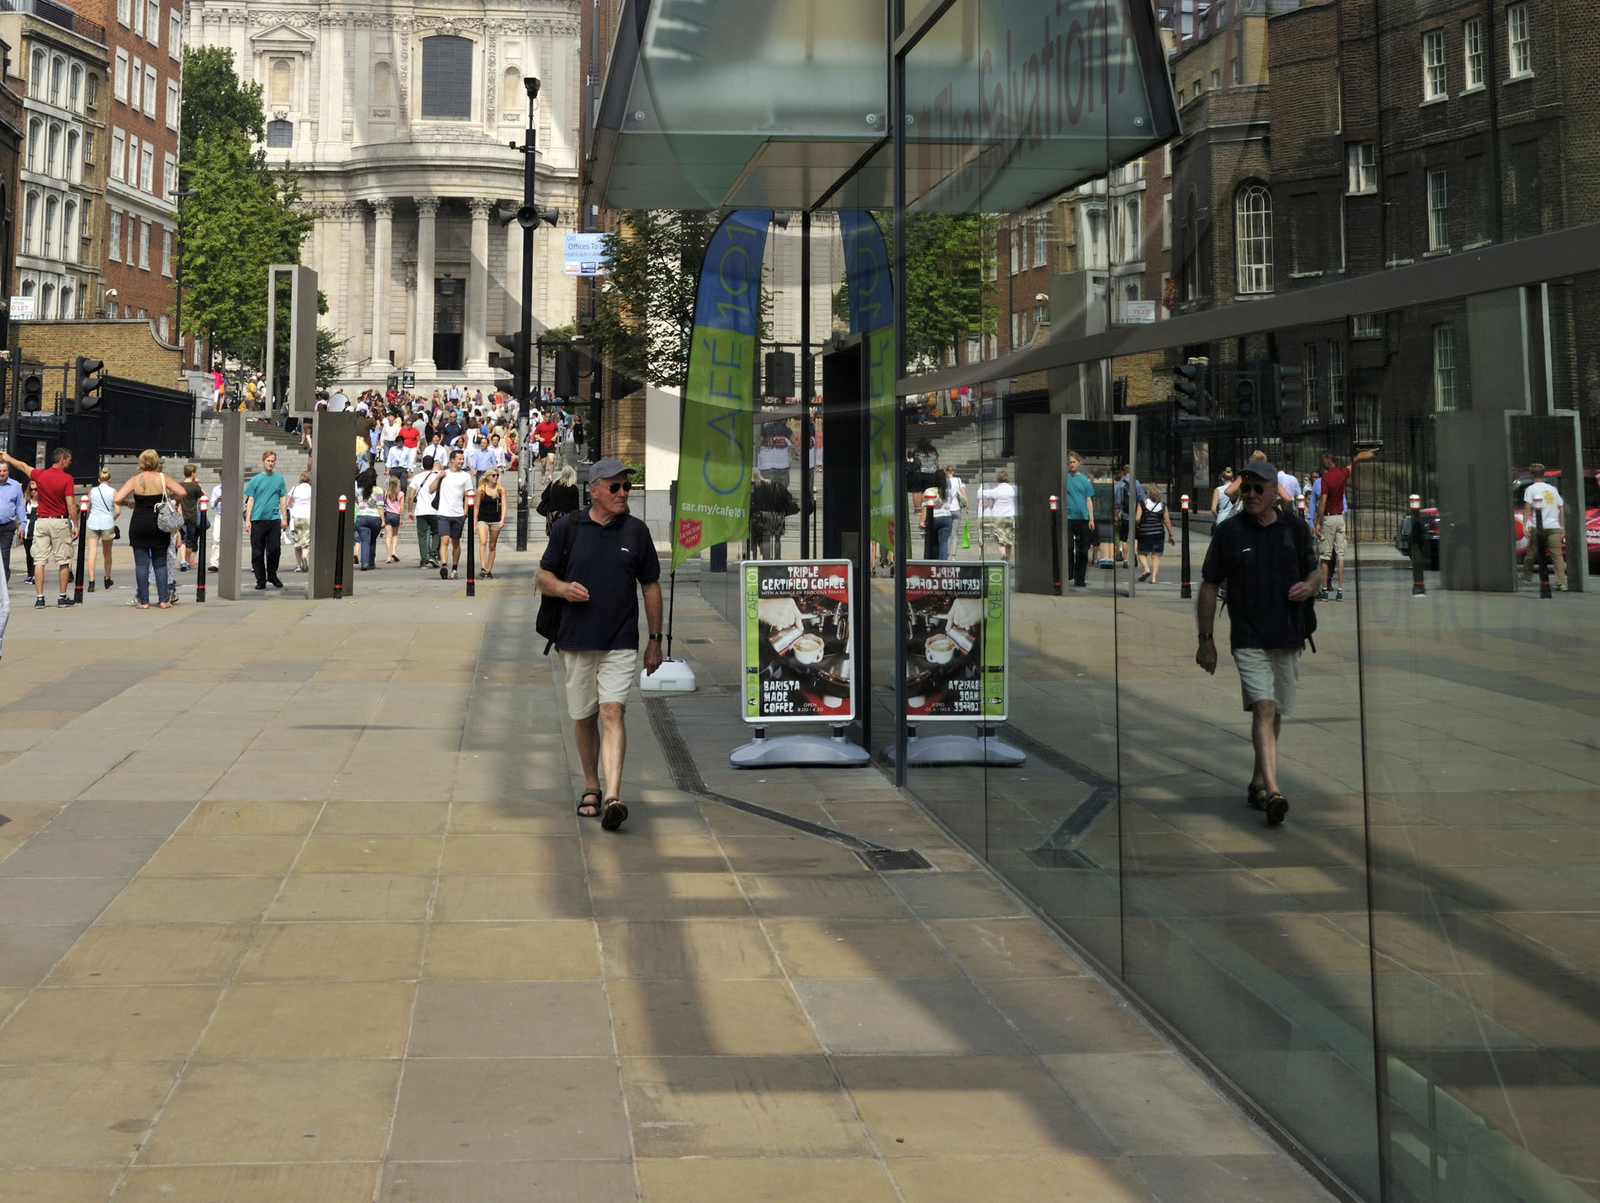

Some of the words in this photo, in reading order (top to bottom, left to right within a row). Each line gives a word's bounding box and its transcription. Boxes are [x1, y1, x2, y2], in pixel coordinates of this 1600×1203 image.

[935, 83, 972, 208] The
[716, 223, 757, 319] 101
[702, 338, 746, 495] CAFÉ
[681, 502, 745, 518] sar.my/cafe101
[747, 568, 758, 587] 101
[787, 566, 819, 578] TRIPLE
[762, 578, 808, 590] CERTIFIED
[811, 578, 845, 590] COFFEE
[763, 680, 800, 691] BARISTA
[764, 691, 788, 702] MADE
[763, 702, 794, 713] COFFEE
